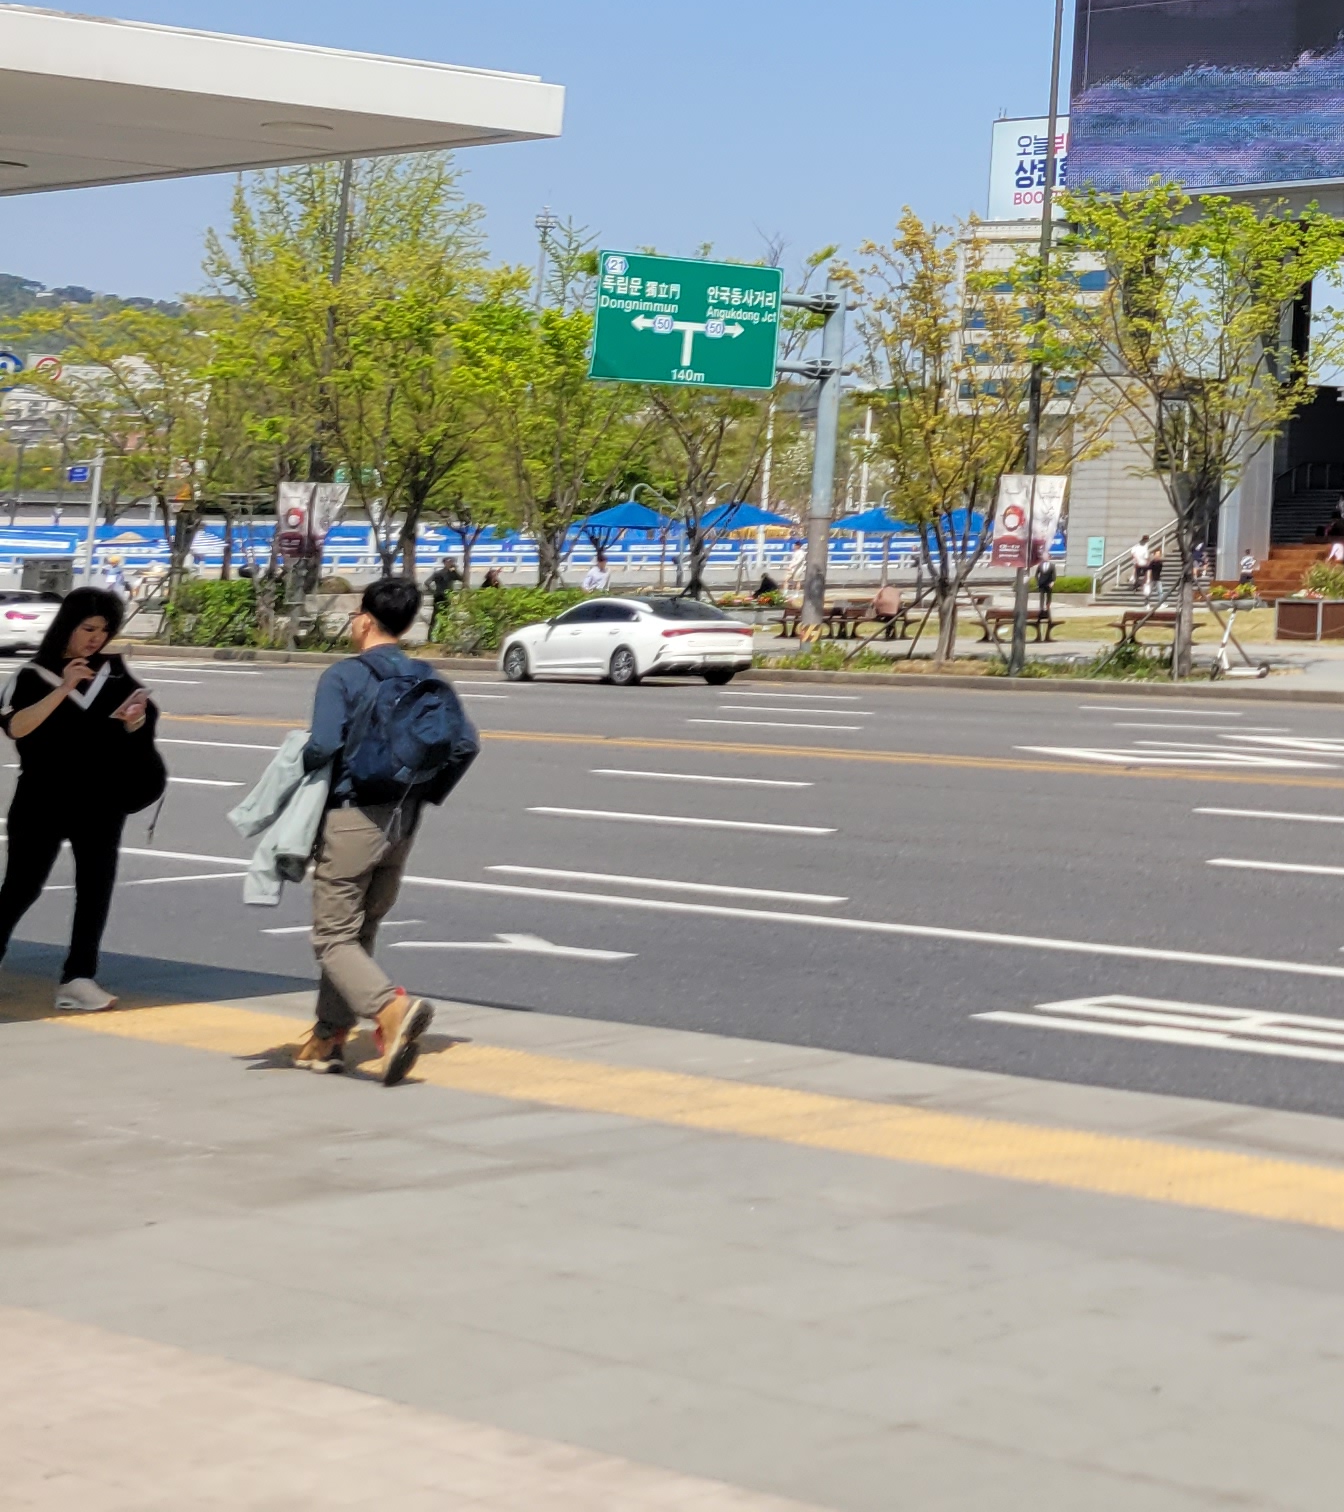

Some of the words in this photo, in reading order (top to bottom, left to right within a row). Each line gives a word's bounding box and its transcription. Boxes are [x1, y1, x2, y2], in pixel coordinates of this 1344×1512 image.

[1016, 133, 1068, 156] 오늘부
[610, 260, 624, 271] 21
[603, 275, 643, 296] 독립문
[645, 281, 681, 300] 獨立門
[600, 295, 679, 313] Dongnimmun
[706, 286, 777, 310] 안국동사거리
[656, 318, 672, 330] 50
[706, 306, 760, 324] Angukdong
[762, 310, 777, 324] Jct
[708, 322, 723, 335] 50
[671, 368, 705, 382] 140m
